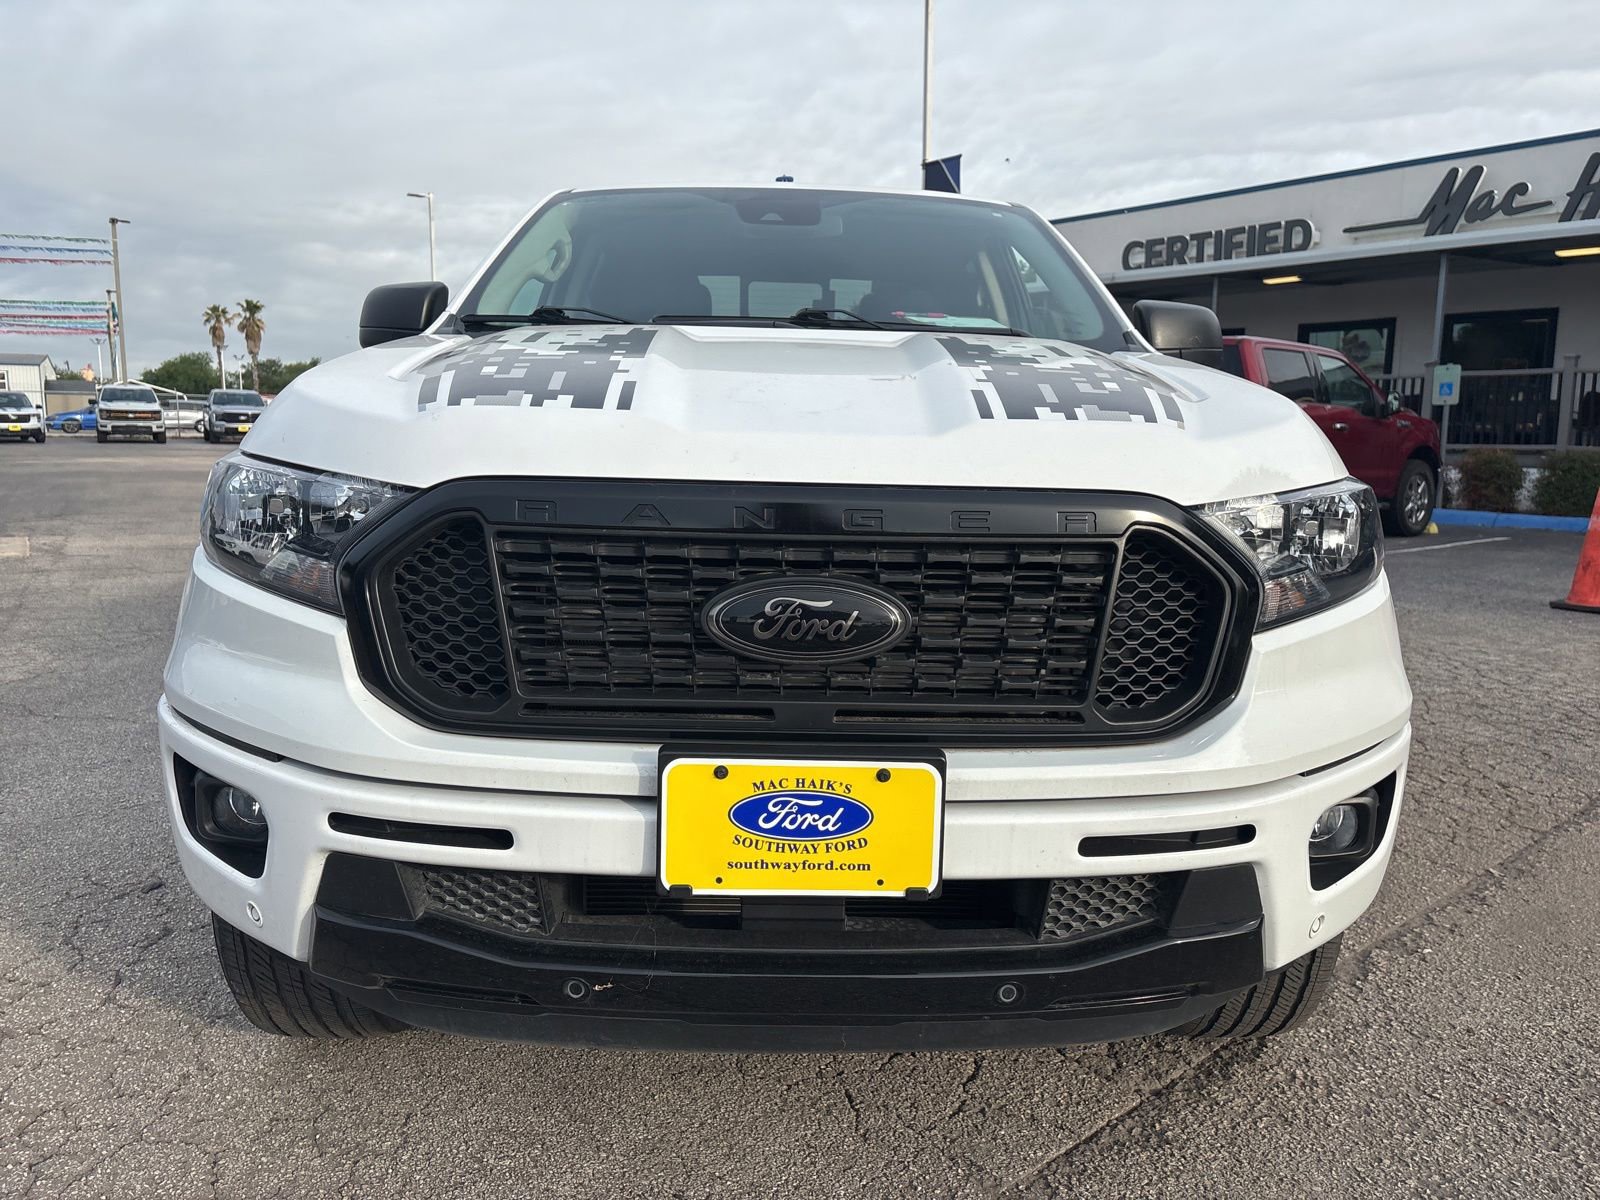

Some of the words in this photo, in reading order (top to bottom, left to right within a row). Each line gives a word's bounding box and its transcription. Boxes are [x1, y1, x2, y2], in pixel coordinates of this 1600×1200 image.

[1343, 165, 1553, 236] Mac
[1122, 219, 1314, 271] CERTIFIED
[515, 499, 1097, 533] RANGER
[753, 597, 859, 642] Ford
[752, 778, 789, 793] MAC
[795, 778, 853, 794] HAIK'S
[758, 797, 845, 832] Ford
[732, 834, 820, 854] SOUTHWAY
[825, 837, 868, 854] FORD
[727, 859, 871, 872] southwayford.com
